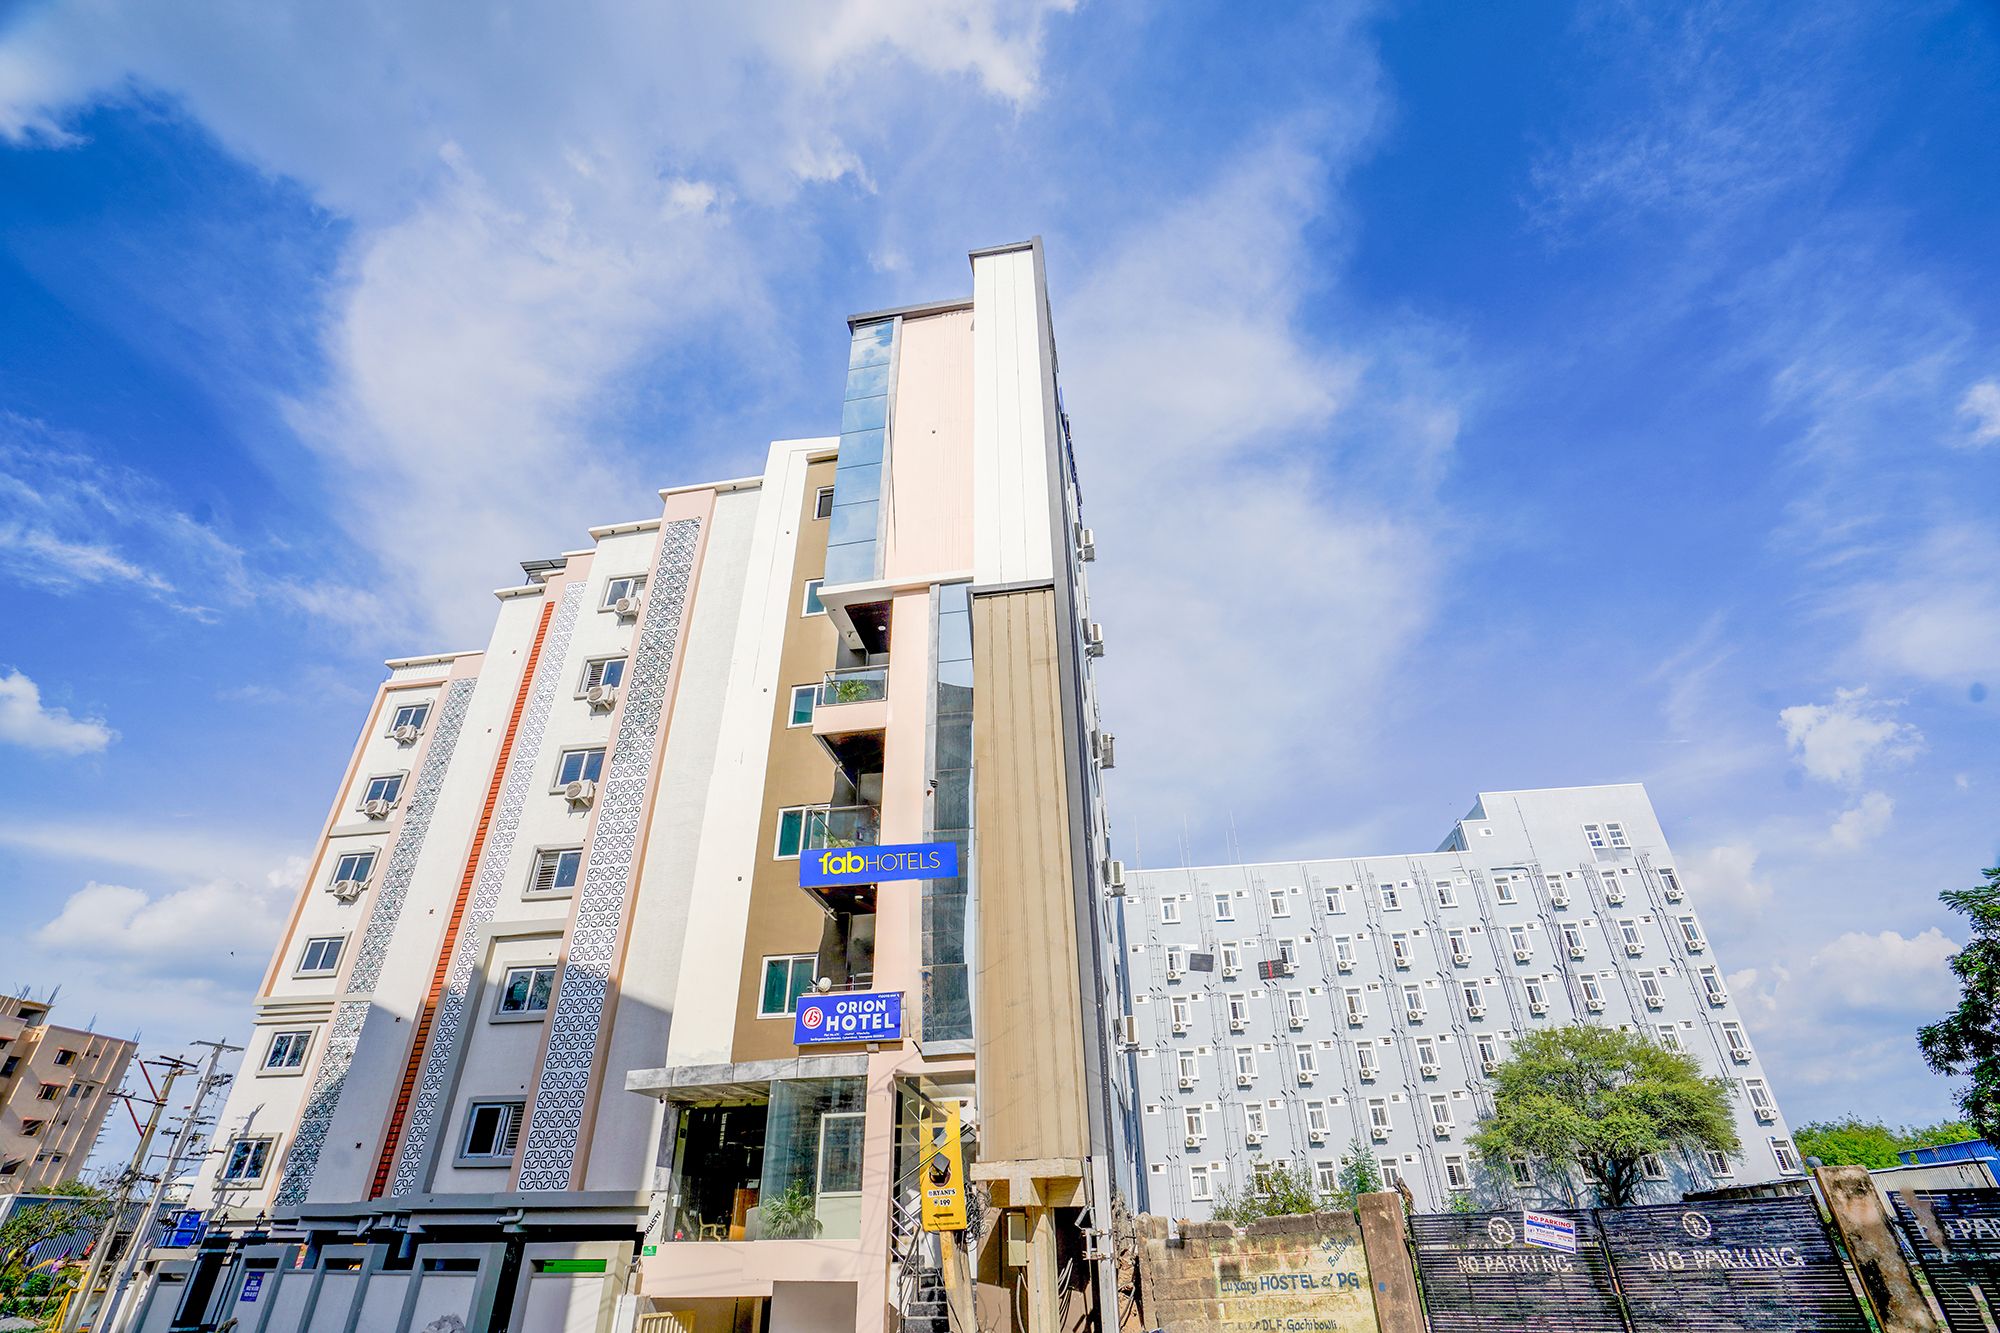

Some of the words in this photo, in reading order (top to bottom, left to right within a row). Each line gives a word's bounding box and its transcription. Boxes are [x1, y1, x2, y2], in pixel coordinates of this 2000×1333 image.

[836, 1000, 886, 1014] ORION
[826, 1012, 896, 1032] HOTEL
[1540, 1217, 1572, 1228] PARKING
[1321, 1237, 1337, 1254] New
[1328, 1235, 1356, 1268] Building
[1456, 1255, 1480, 1273] NO
[1484, 1254, 1574, 1273] PARKING
[1648, 1250, 1685, 1271] NO
[1693, 1247, 1805, 1270] PARKING
[1260, 1274, 1319, 1291] HOSTEL
[1336, 1272, 1360, 1290] PG
